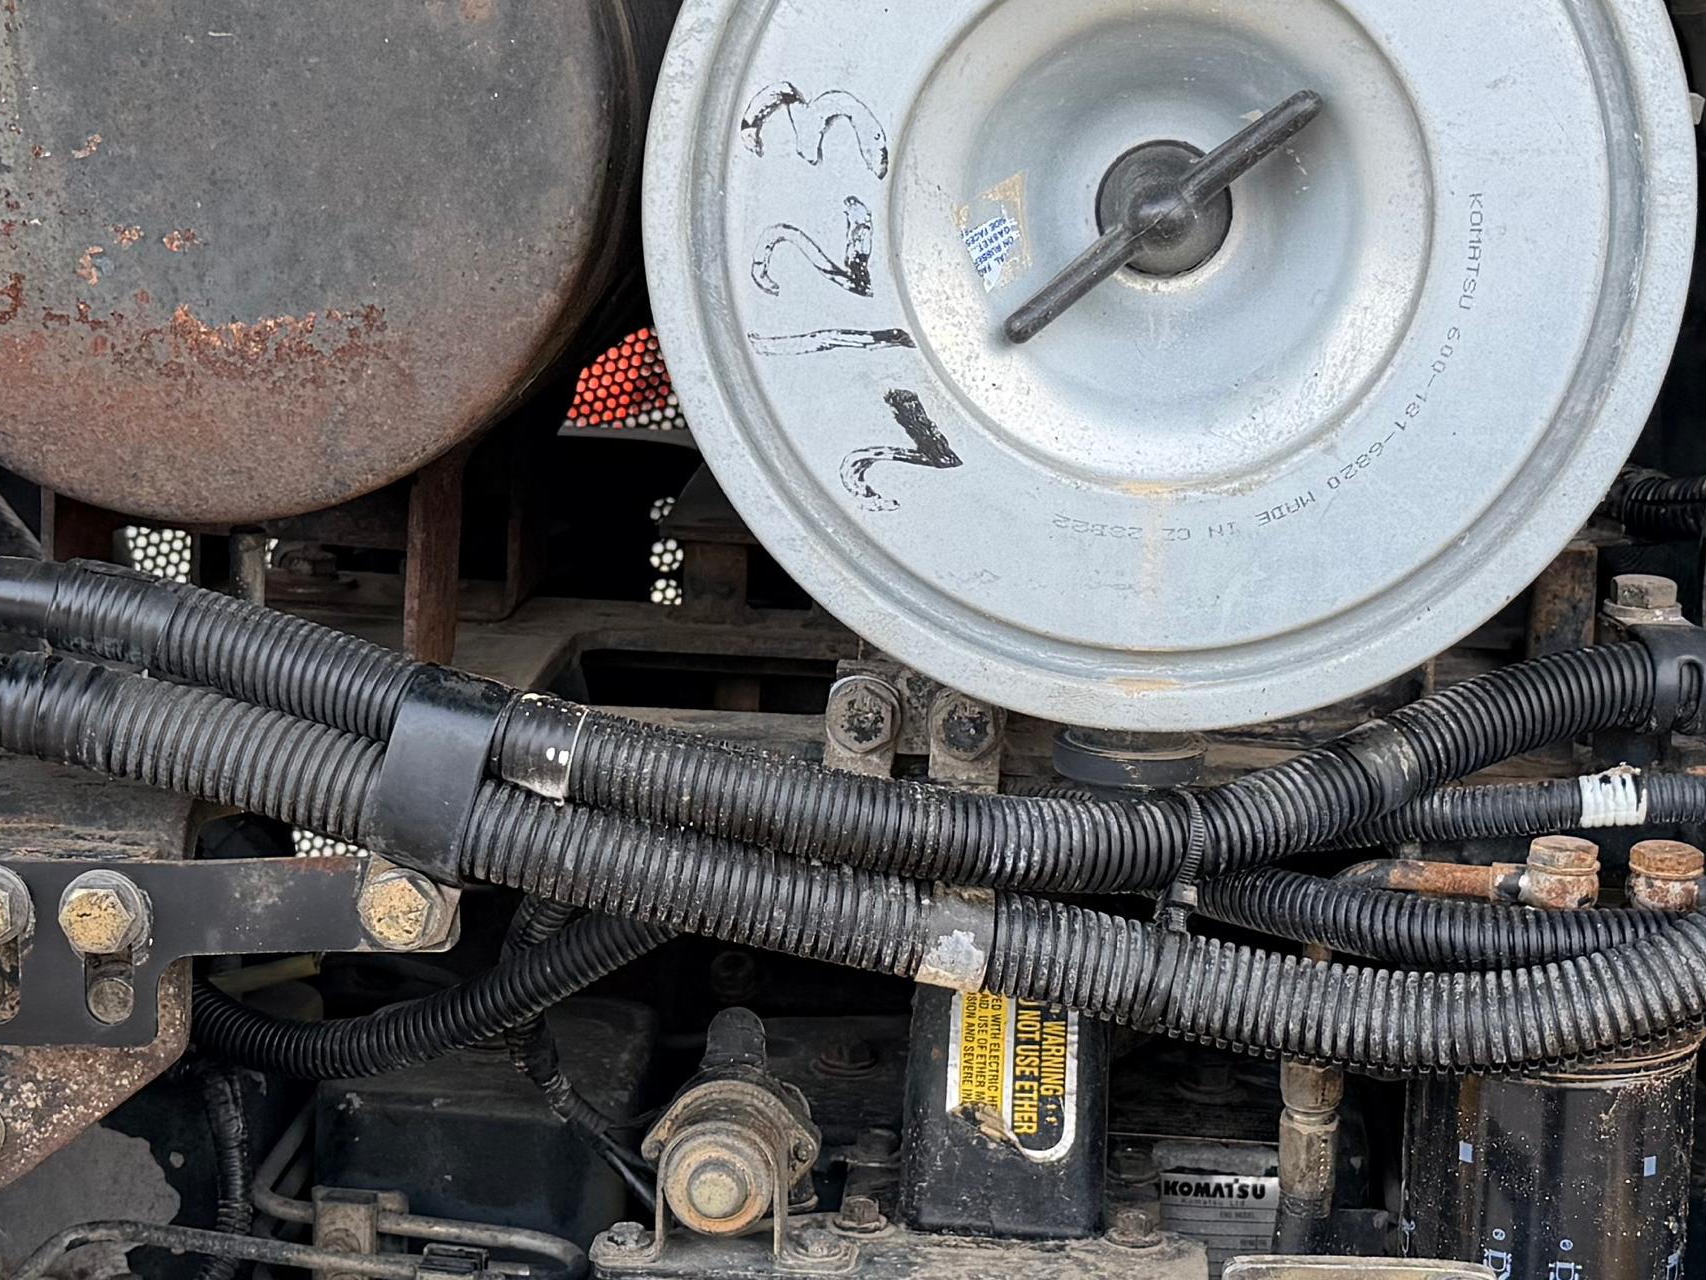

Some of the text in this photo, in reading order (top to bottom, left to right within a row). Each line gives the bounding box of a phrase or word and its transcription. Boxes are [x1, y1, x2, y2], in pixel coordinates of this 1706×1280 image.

[1458, 193, 1483, 310] KOMATSU
[1326, 326, 1461, 490] 600-181-6820
[1254, 491, 1316, 527] MADE
[1208, 521, 1239, 538] IN
[963, 1021, 975, 1043] AND
[977, 1015, 988, 1035] USE
[989, 1014, 1001, 1039] WITH
[1017, 1010, 1041, 1041] NOT
[976, 1038, 987, 1051] OF
[1015, 1045, 1039, 1076] USE
[1040, 1021, 1066, 1096] WARNING
[962, 1045, 974, 1086] SEVERE
[976, 1053, 987, 1088] ETHER
[988, 1043, 1000, 1092] ELECTRIC
[1013, 1080, 1038, 1135] ETHER
[1163, 1177, 1266, 1200] KOMATSU
